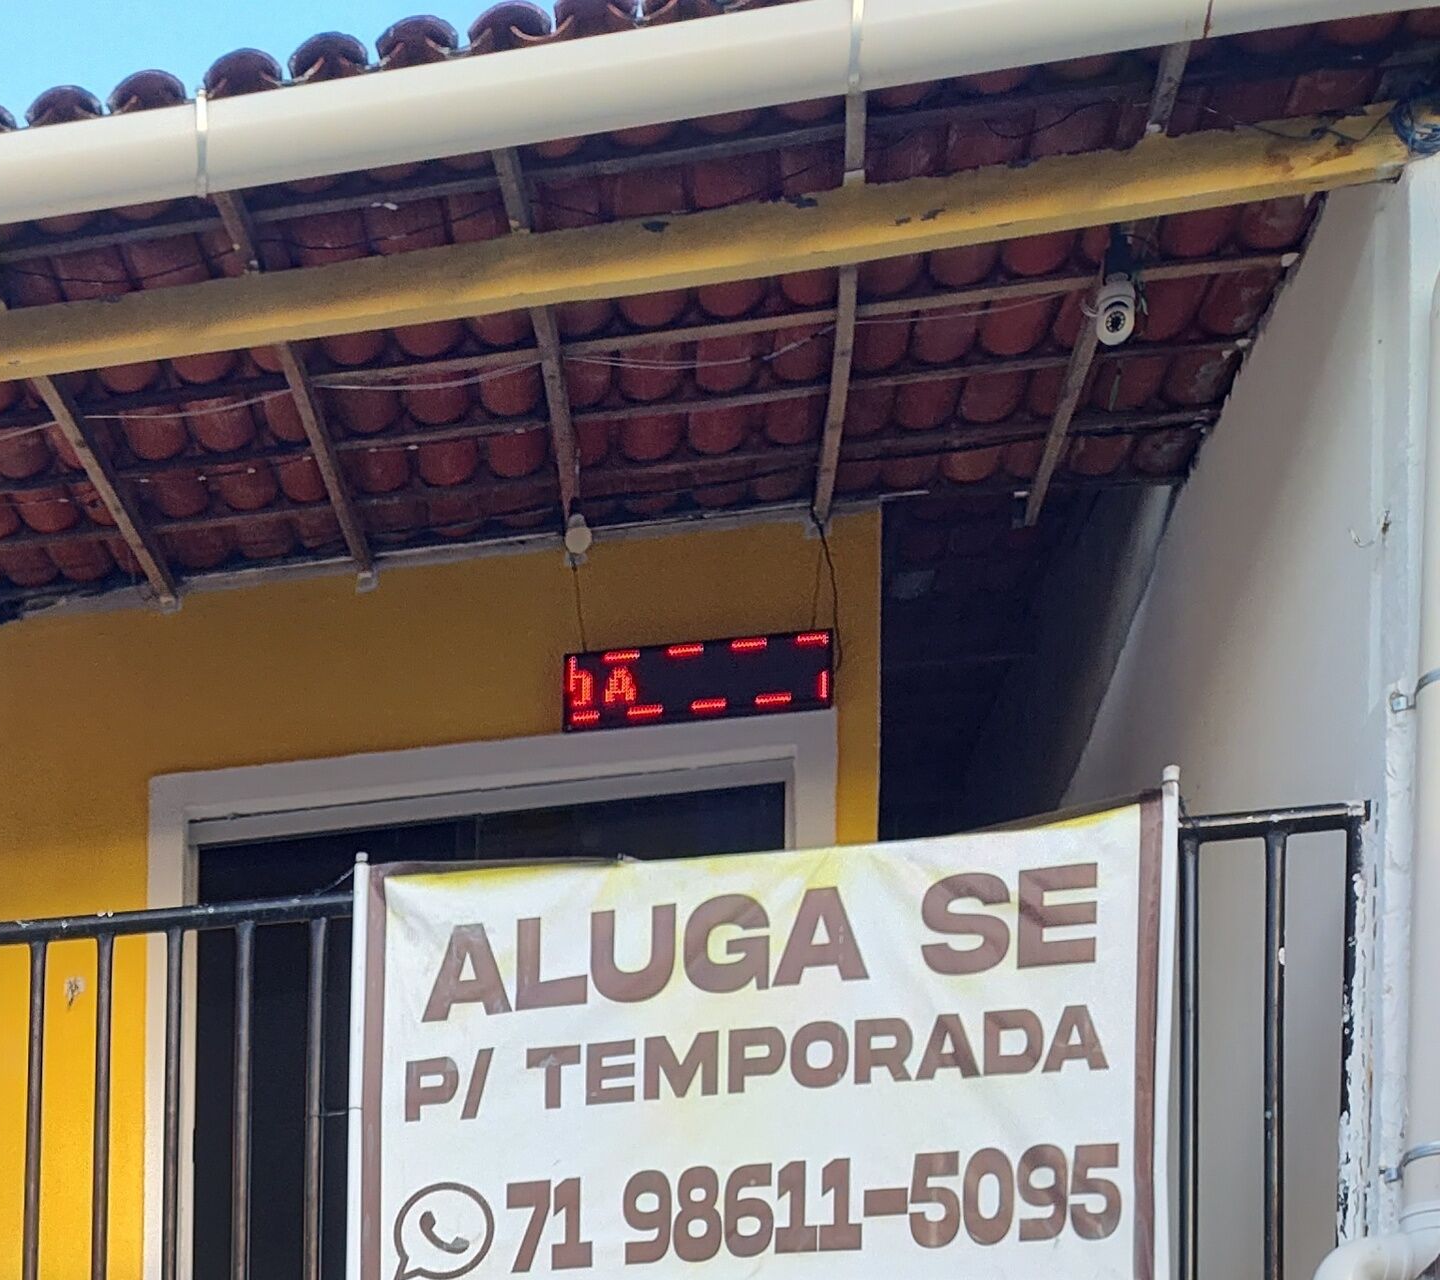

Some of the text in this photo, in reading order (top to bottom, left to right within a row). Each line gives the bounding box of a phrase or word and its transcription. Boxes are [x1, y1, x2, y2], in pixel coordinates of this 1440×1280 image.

[421, 862, 1099, 1023] ALUGA SE
[404, 1004, 1109, 1123] P/ TEMPORADA
[505, 1143, 1123, 1274] 71 98611-5095
